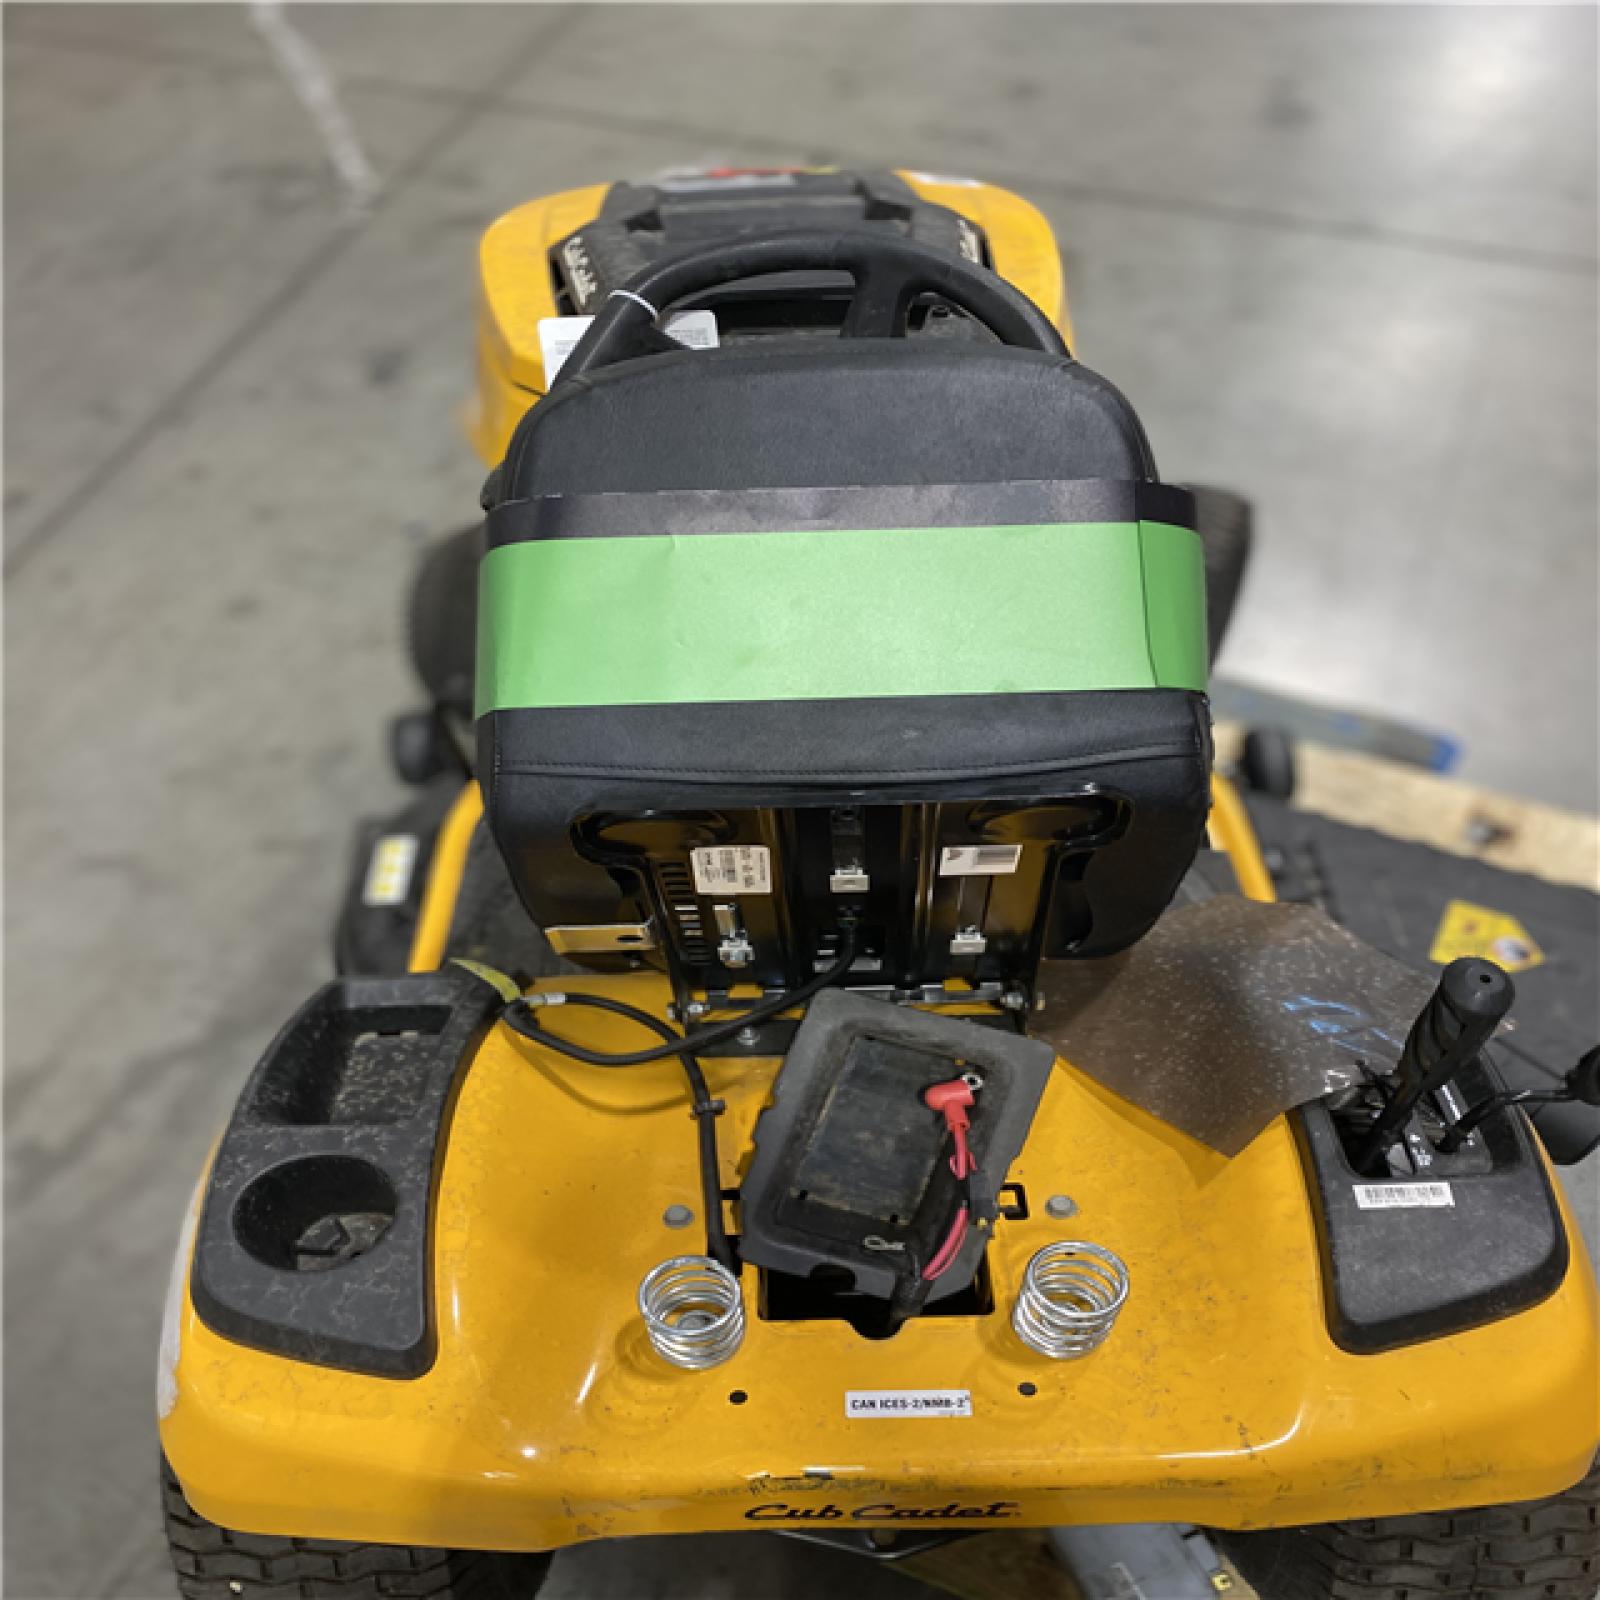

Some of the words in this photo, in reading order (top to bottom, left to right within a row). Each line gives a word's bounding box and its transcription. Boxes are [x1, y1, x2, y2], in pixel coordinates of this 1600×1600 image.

[851, 1399, 877, 1411] CAN
[745, 1504, 844, 1520] Cub
[852, 1502, 1019, 1520] Cadet
